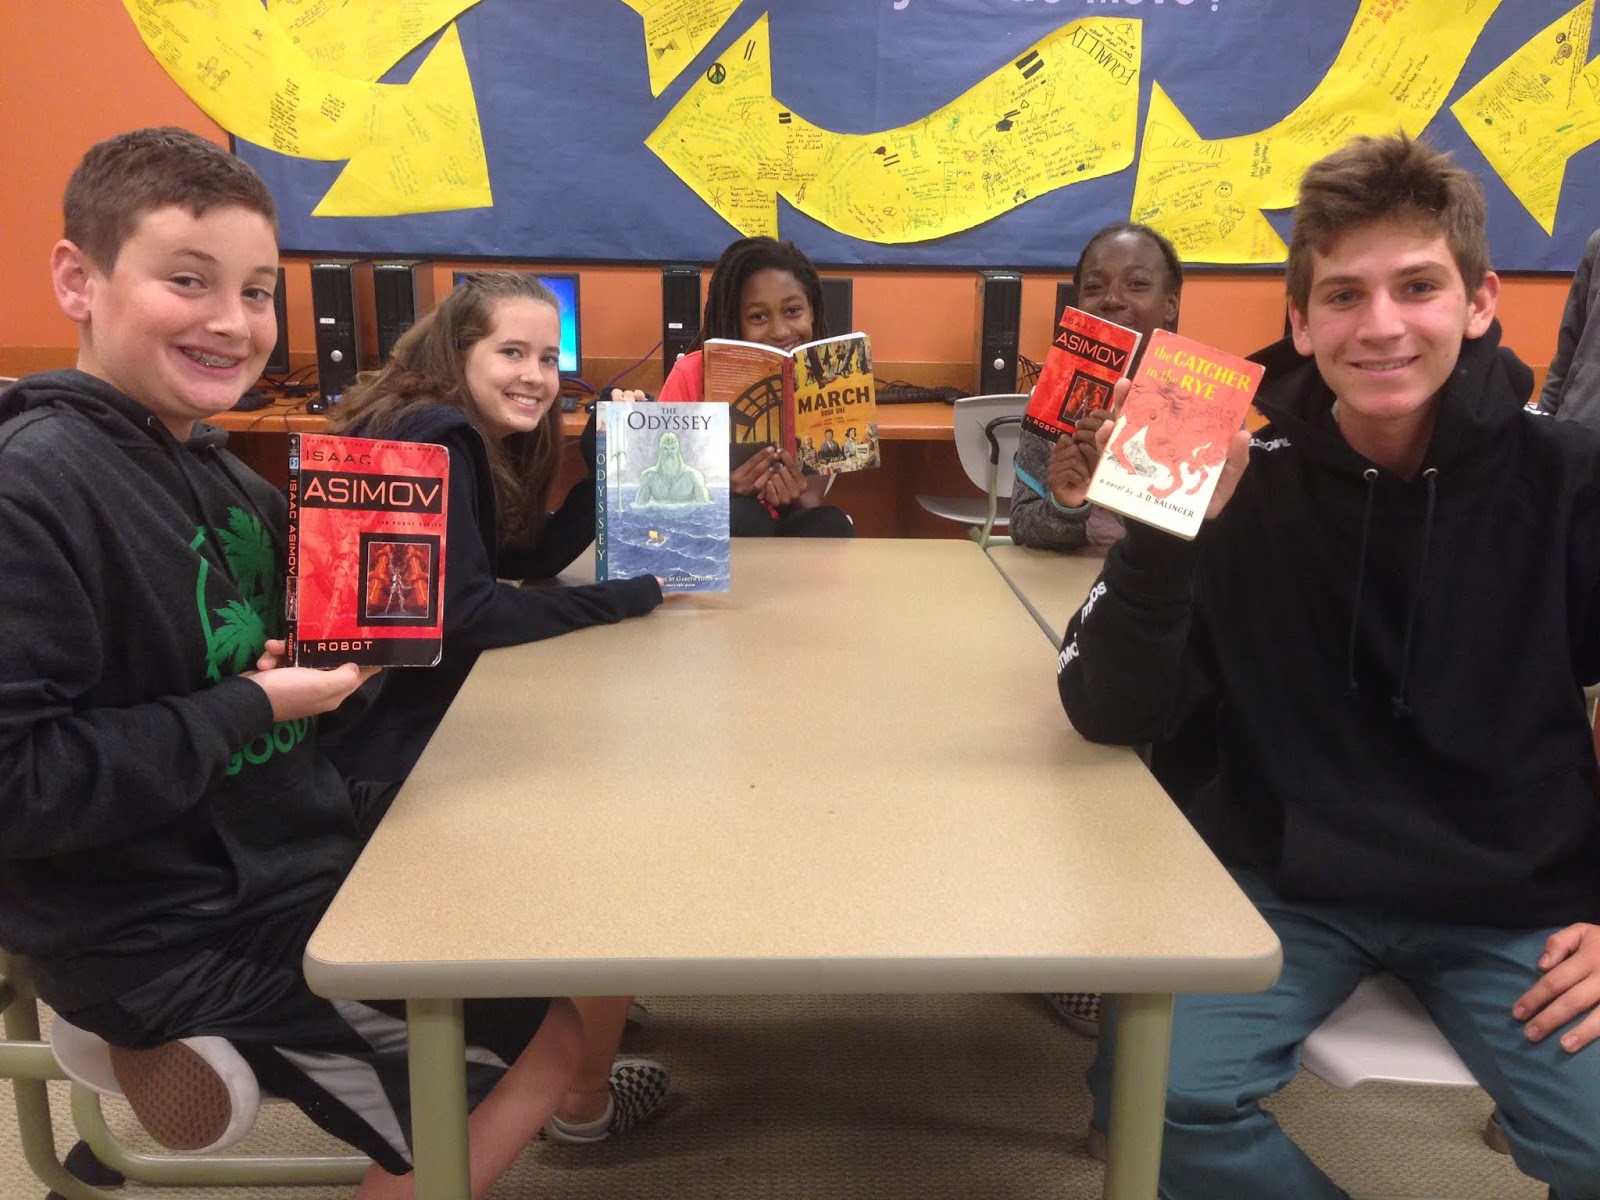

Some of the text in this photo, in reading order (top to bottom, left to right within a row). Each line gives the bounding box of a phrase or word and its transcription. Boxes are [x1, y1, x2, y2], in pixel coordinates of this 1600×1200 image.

[1066, 26, 1137, 85] EQUALITY
[1055, 331, 1125, 367] ASIMOV
[1146, 367, 1219, 401] in the RYE
[1153, 344, 1252, 393] the CATCHER
[661, 407, 677, 415] THE
[798, 386, 870, 415] MARCH
[821, 408, 834, 416] BOOK
[627, 410, 712, 430] ODYSSEY
[1033, 419, 1062, 435] ROBOT
[306, 450, 371, 465] ISAAC
[304, 476, 440, 507] ASIMOV
[596, 453, 606, 561] ODYSSEY
[1105, 481, 1125, 491] novel
[1124, 487, 1134, 495] by
[1154, 498, 1194, 518] SALINGER
[288, 479, 297, 576] ISAAC ASIMOV
[318, 641, 373, 651] ROBOT
